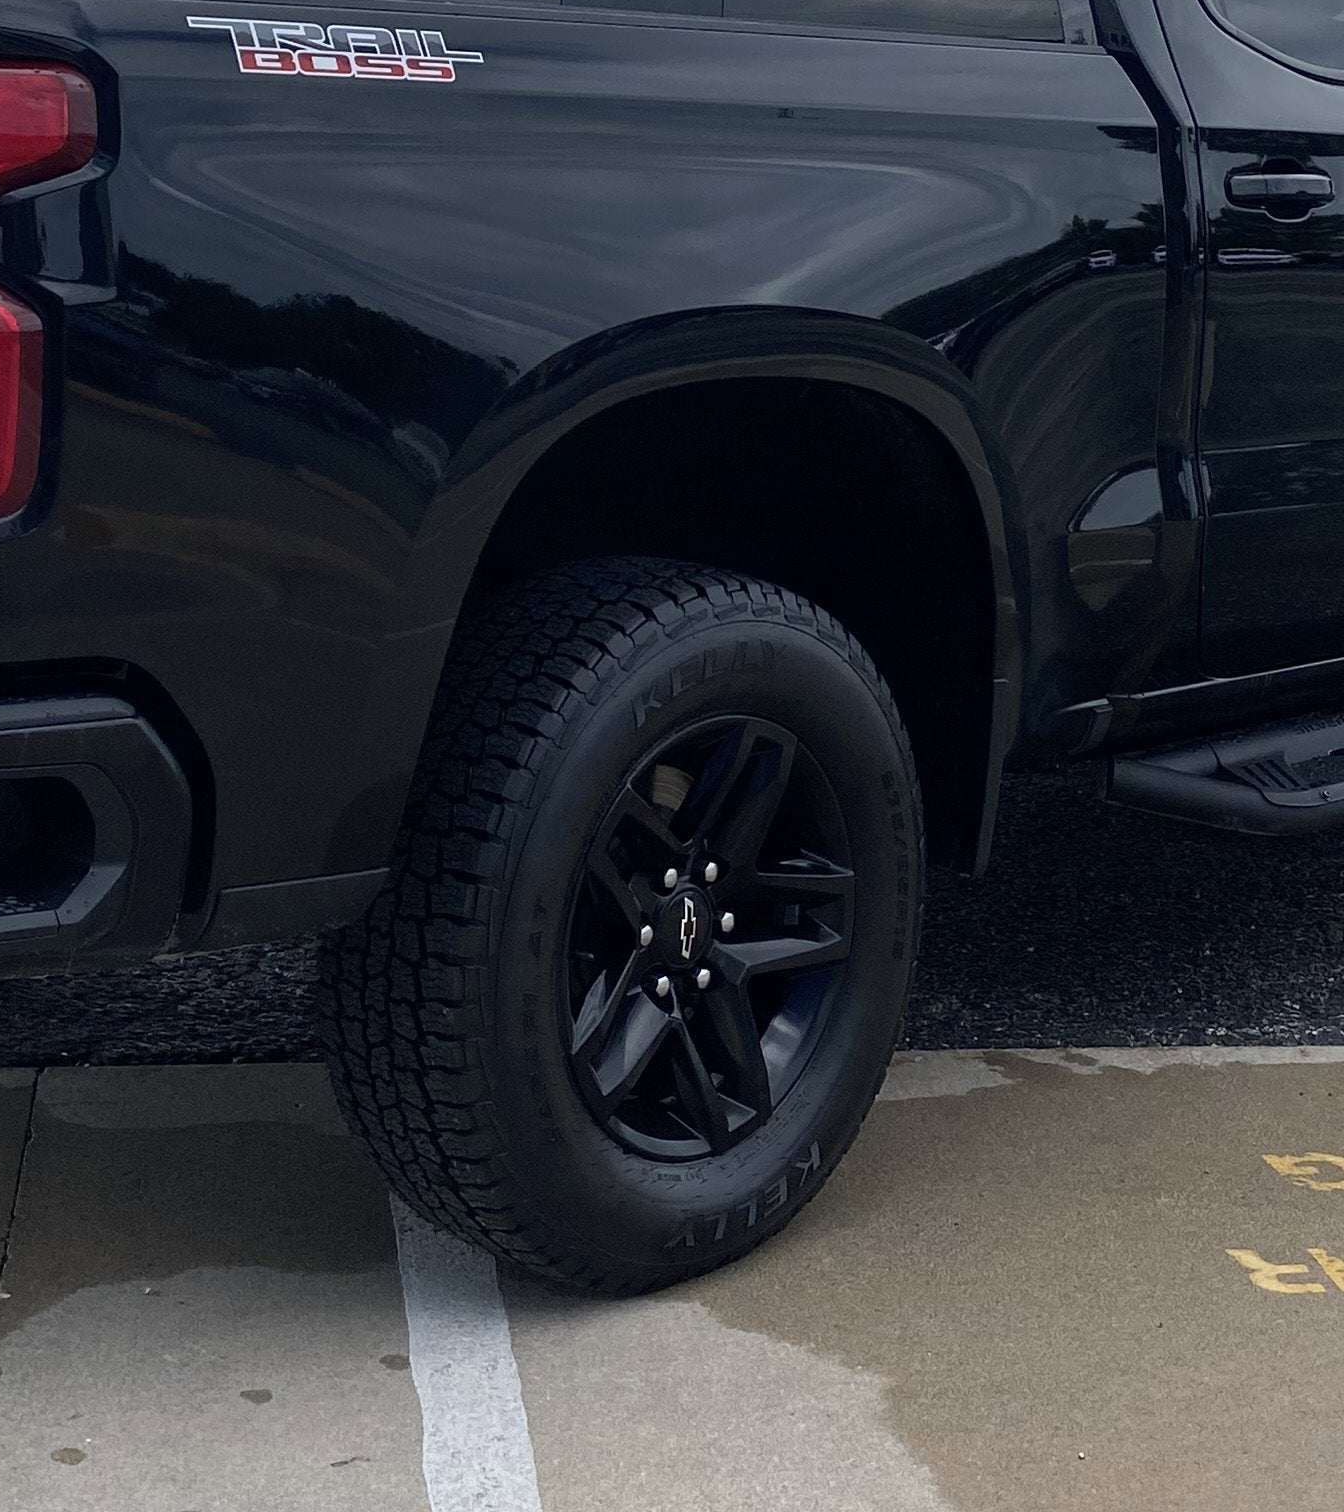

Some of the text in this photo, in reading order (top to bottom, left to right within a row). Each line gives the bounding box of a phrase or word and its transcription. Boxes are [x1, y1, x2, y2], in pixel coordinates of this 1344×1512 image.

[186, 16, 484, 63] TRAIL
[236, 50, 455, 82] BOSS
[664, 1138, 822, 1252] KELLY
